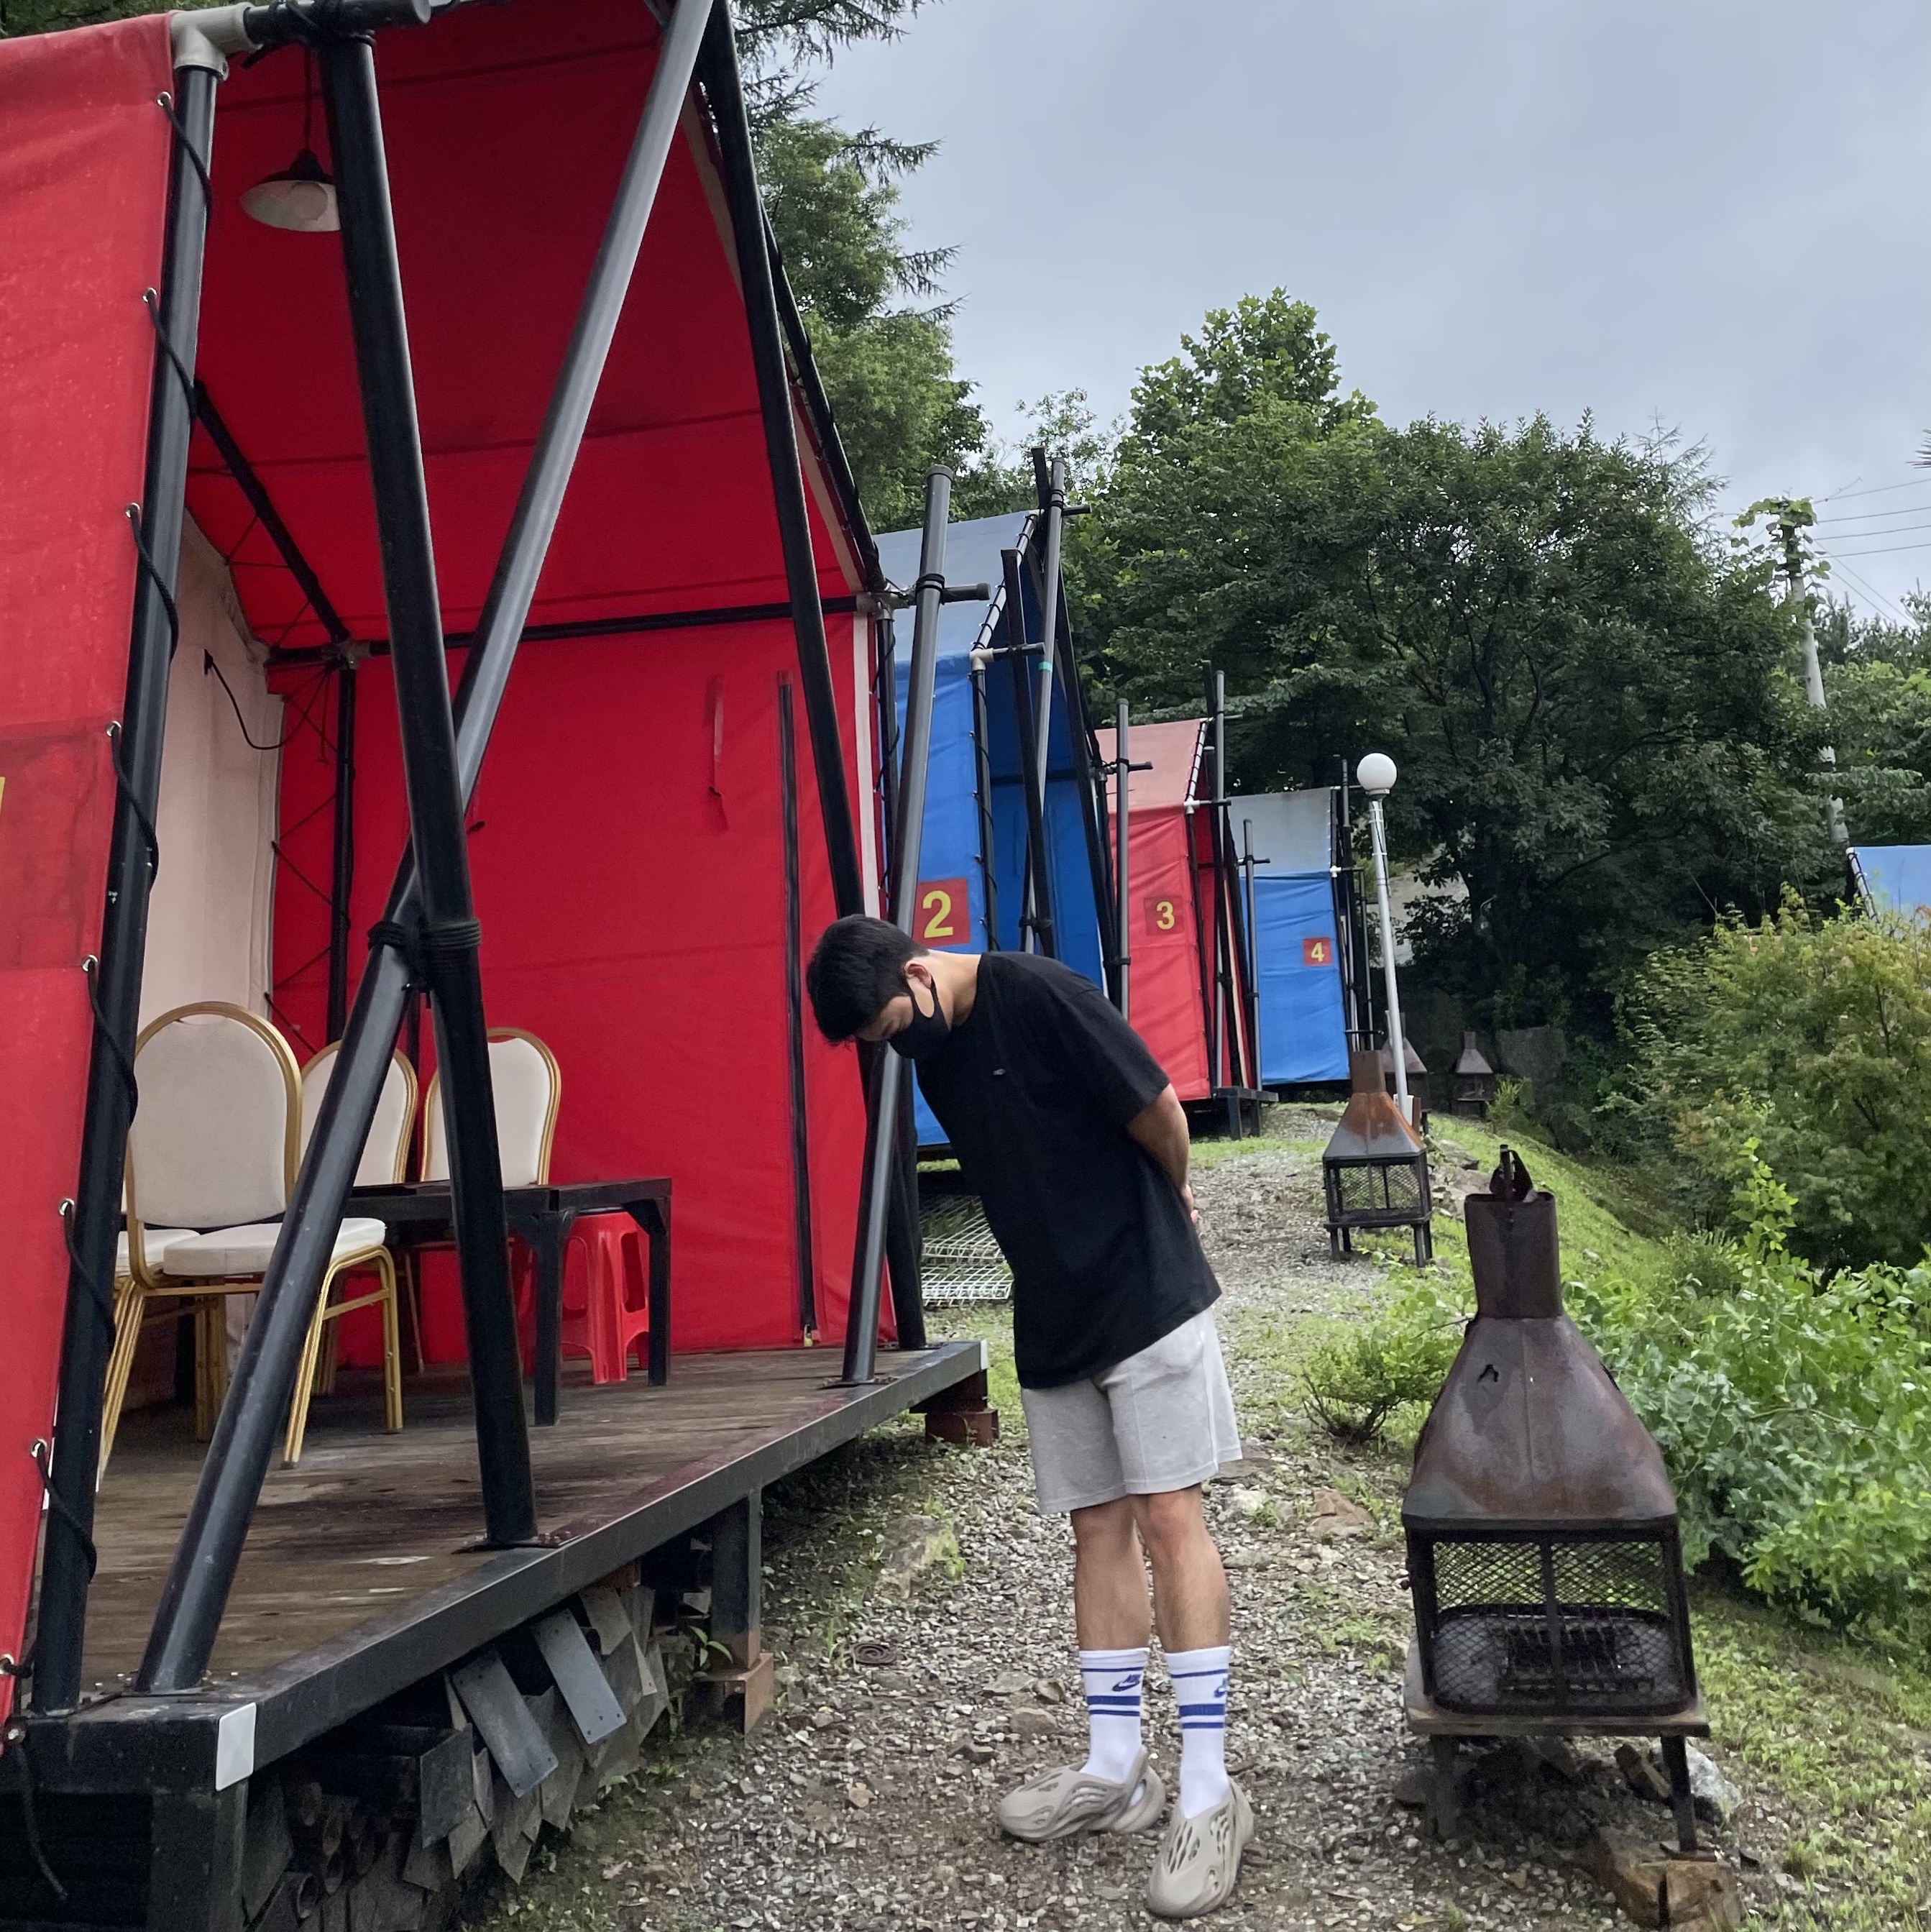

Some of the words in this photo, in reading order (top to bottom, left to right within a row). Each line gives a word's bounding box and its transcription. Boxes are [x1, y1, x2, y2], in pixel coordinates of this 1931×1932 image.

[922, 890, 953, 938] 2
[1156, 901, 1175, 930] 3
[1311, 942, 1325, 962] 4
